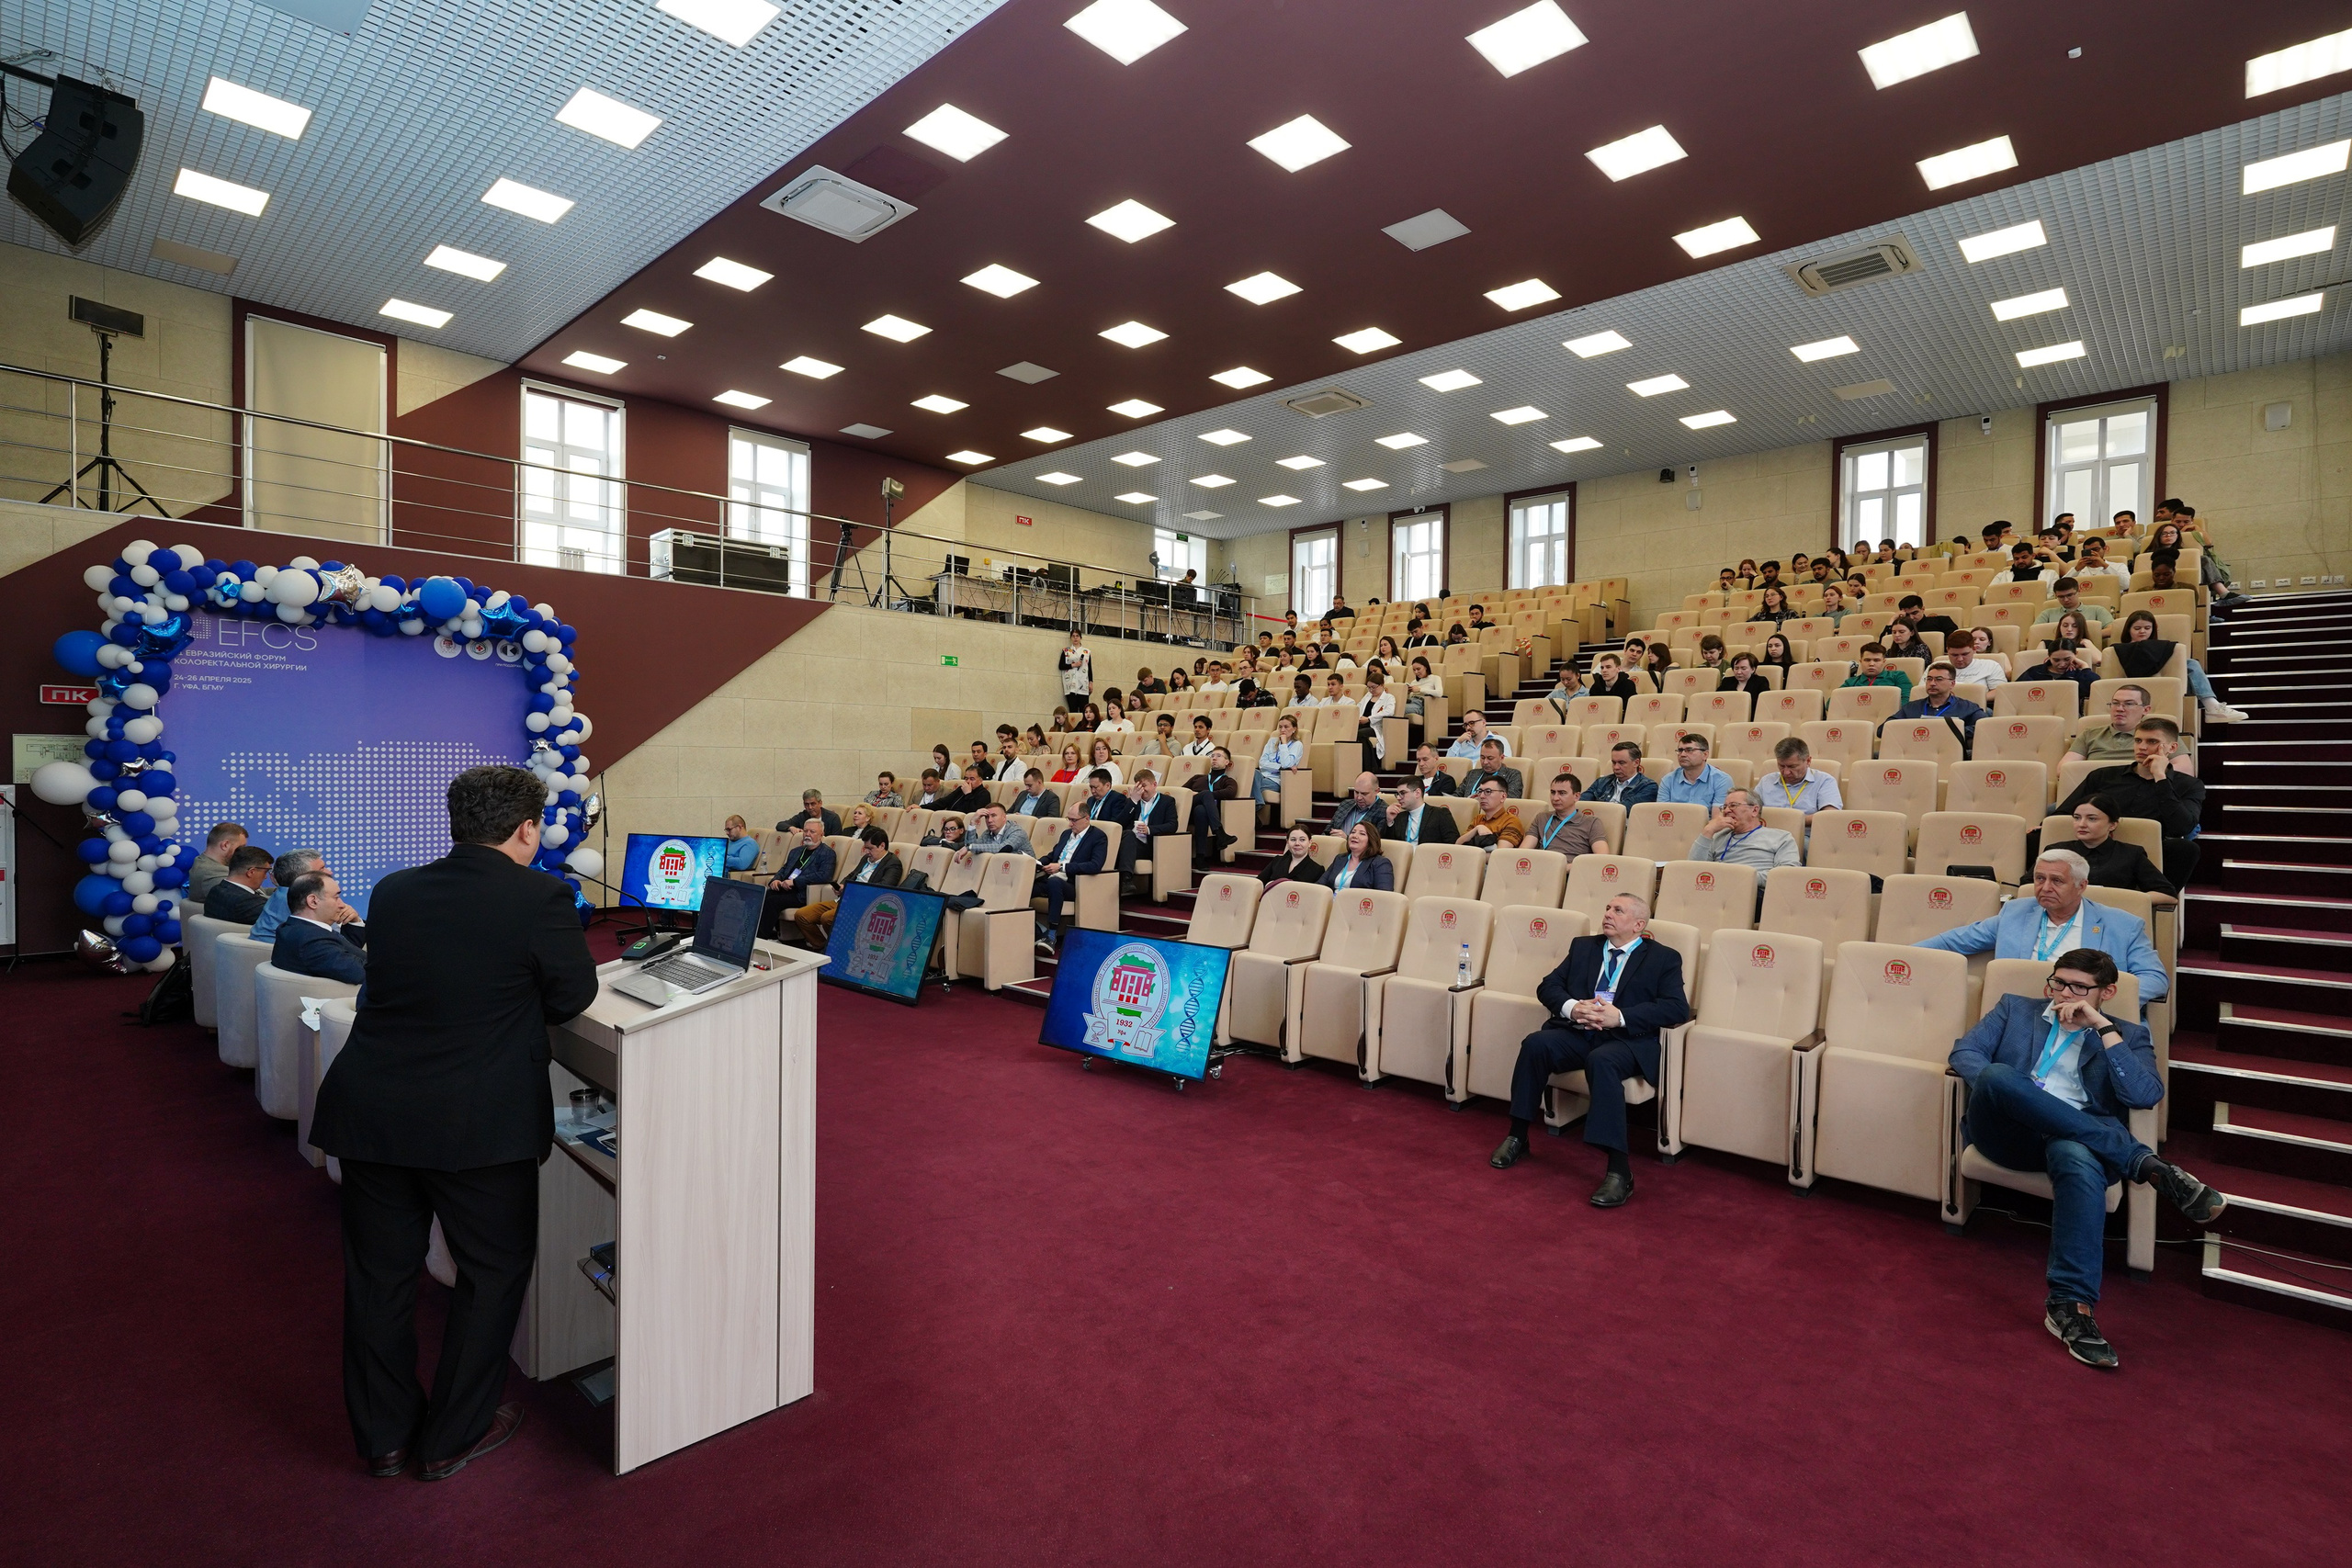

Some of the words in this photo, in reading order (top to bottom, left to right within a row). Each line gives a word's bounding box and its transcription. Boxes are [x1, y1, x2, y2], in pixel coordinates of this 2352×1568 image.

[219, 618, 318, 651] EFCS
[186, 650, 252, 660] ЕВРАЗИЙСКИЙ
[254, 653, 287, 661] ФОРУМ
[175, 658, 261, 669] КОЛОРЕКТАЛЬНОЙ
[264, 662, 307, 671] ХИРУРГИИ
[51, 690, 89, 701] ПК
[1115, 1019, 1133, 1028] 1932
